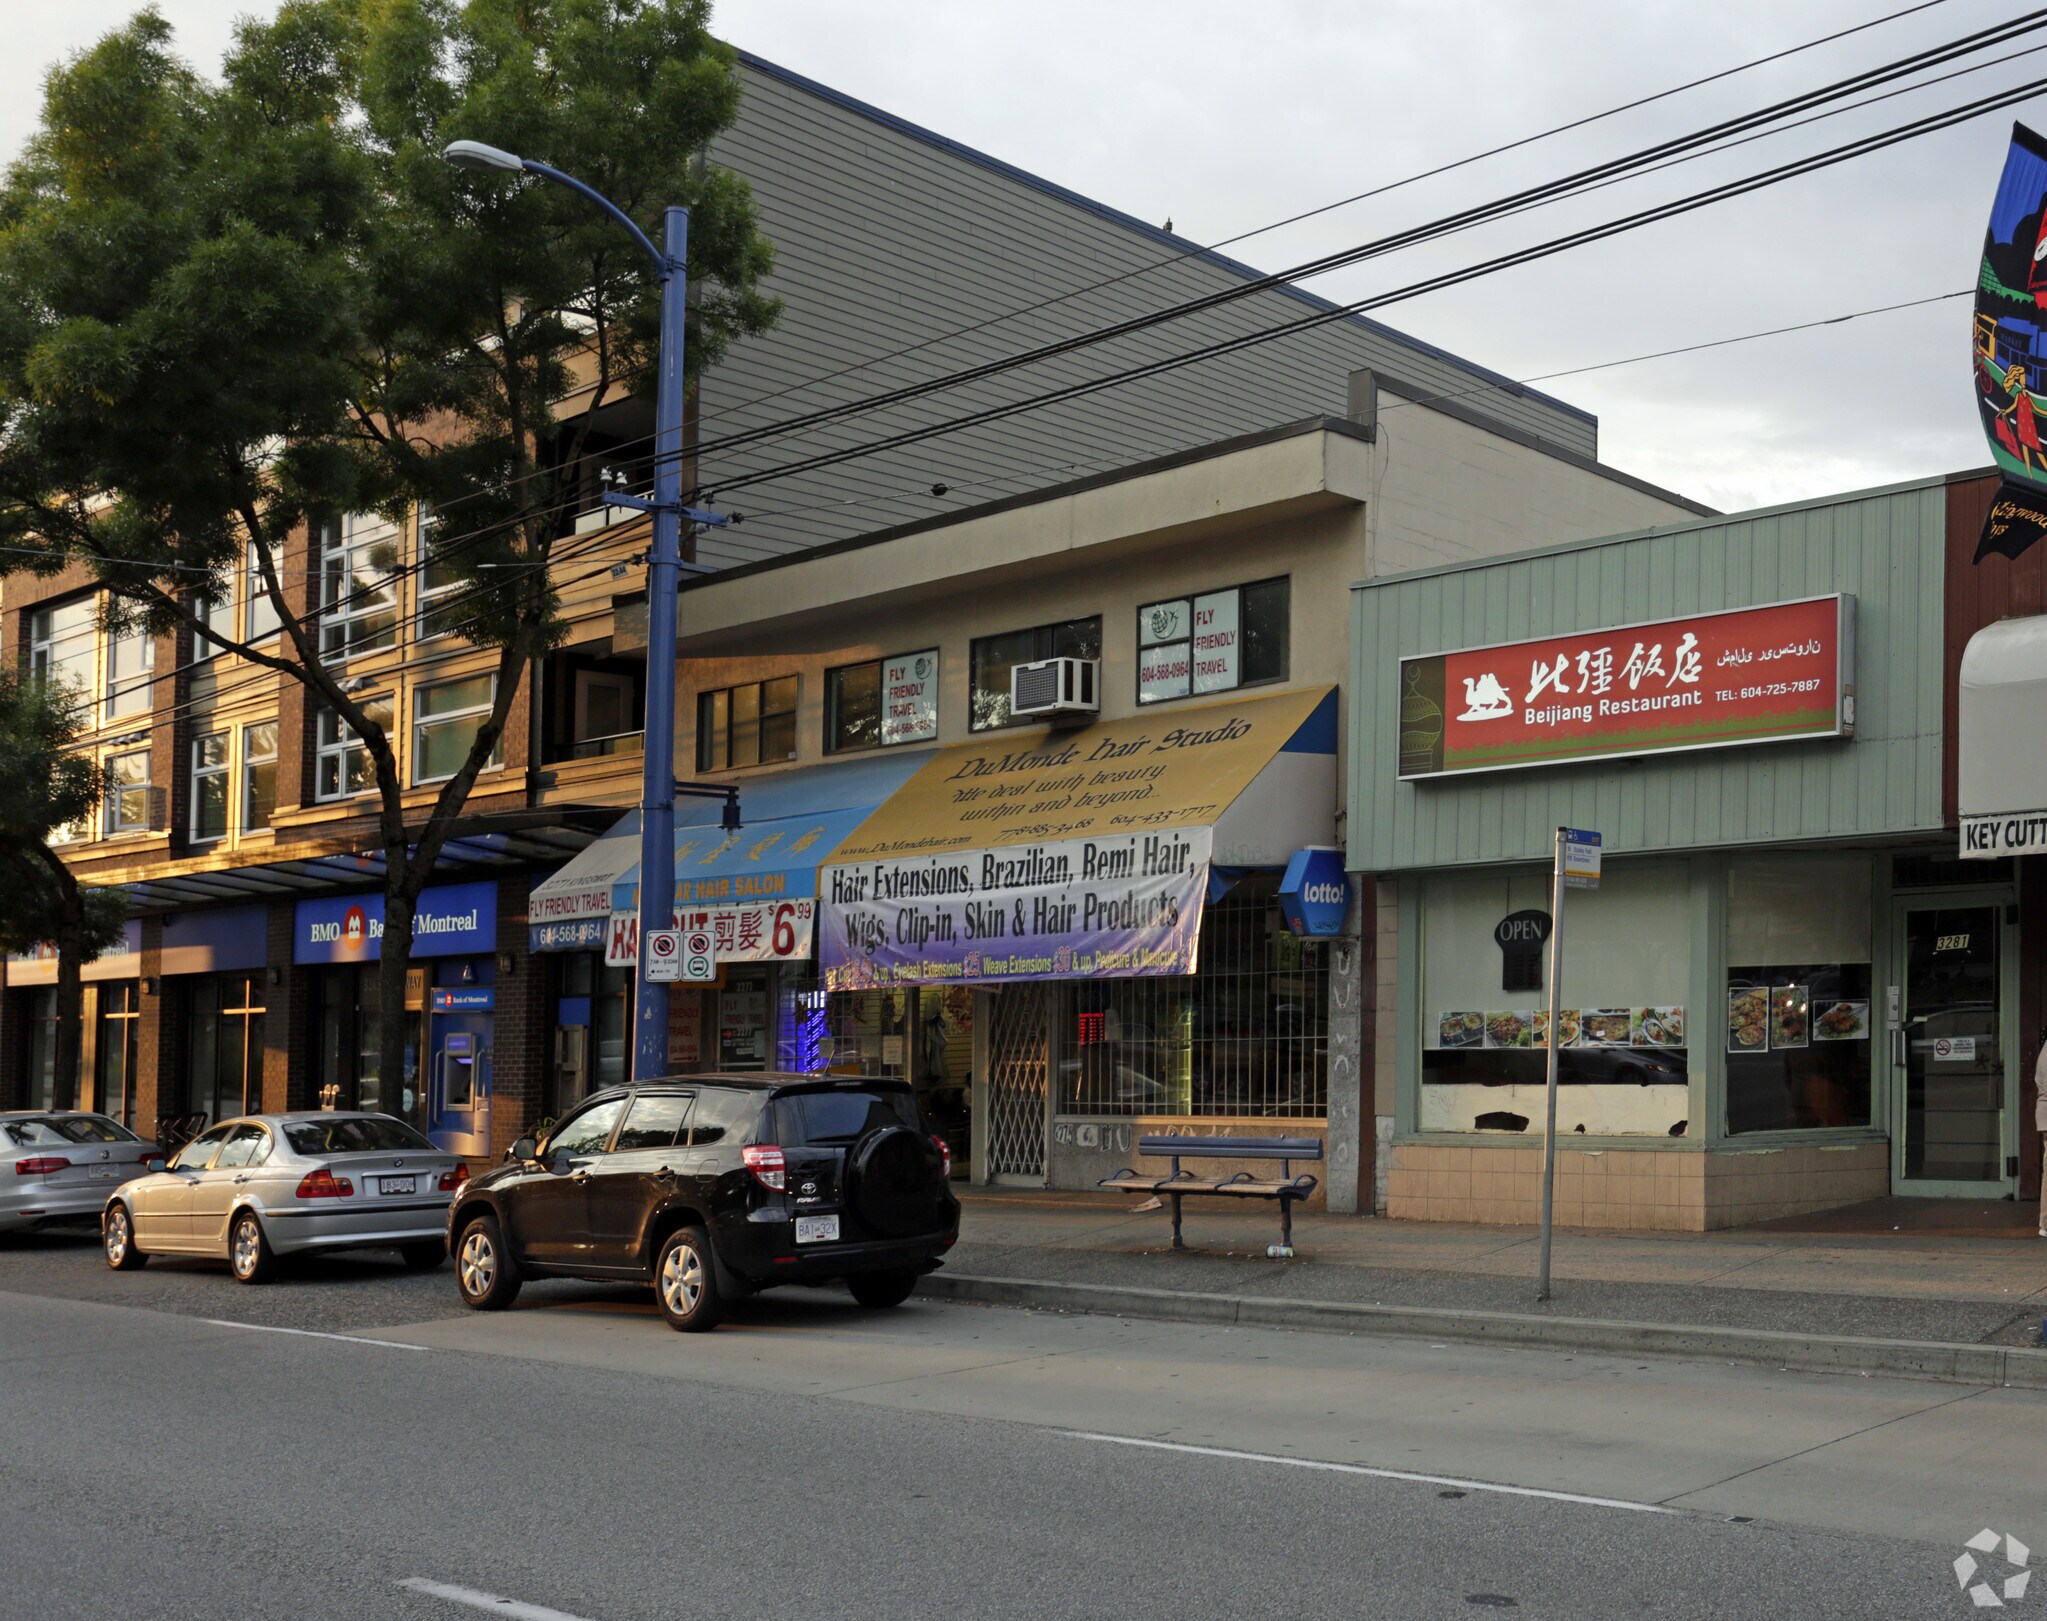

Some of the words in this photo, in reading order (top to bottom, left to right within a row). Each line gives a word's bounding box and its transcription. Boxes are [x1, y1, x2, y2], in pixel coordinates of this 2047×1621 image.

[1196, 609, 1215, 626] FLY
[1196, 630, 1236, 651] FRIENDLY
[889, 667, 906, 682] FLY
[1142, 660, 1189, 683] 604-568-0964
[1196, 658, 1228, 677] TRAVEL
[889, 681, 926, 700] FRIENDLY
[1715, 690, 1738, 702] TEL:
[1740, 678, 1820, 699] 604-725-7887
[889, 702, 917, 719] TRAVEL
[1524, 703, 1593, 727] Beijiang
[1599, 689, 1703, 716] Restaurant
[944, 743, 1082, 783] DuMonde
[1149, 717, 1252, 755] Studio
[1035, 773, 1086, 792] with
[959, 802, 1026, 822] within
[1028, 795, 1072, 813] and
[1110, 804, 1217, 826] 604-433-1717
[1966, 822, 2001, 851] KEY
[2004, 818, 2047, 848] CUTT
[832, 867, 868, 904] Hair
[873, 859, 974, 900] Extensions,
[981, 847, 1073, 892] Brazilian,
[1081, 838, 1136, 882] Remi
[1142, 833, 1195, 879] Hair,
[695, 878, 730, 900] HAIR
[735, 873, 785, 897] SALON
[1304, 881, 1345, 904] lotto!
[530, 899, 544, 918] FLY
[545, 895, 581, 916] FRIENDLY
[582, 891, 611, 911] TRAVEL
[310, 922, 340, 942] BMO
[418, 908, 478, 934] Montreal
[540, 922, 600, 945] 604-568-0964
[845, 912, 889, 956] Wigs,
[896, 904, 957, 952] Clip-in,
[964, 900, 1006, 940] Skin
[1012, 898, 1026, 937] &
[1033, 894, 1077, 935] Hair
[1083, 889, 1179, 932] Products
[1500, 920, 1541, 941] OPEN
[1937, 935, 1968, 951] 3281
[922, 959, 962, 979] Extensions
[983, 956, 1007, 976] Weave
[1009, 953, 1051, 974] Extensions
[1072, 951, 1078, 970] &
[1132, 949, 1138, 967] &
[820, 1222, 837, 1234] 32X
